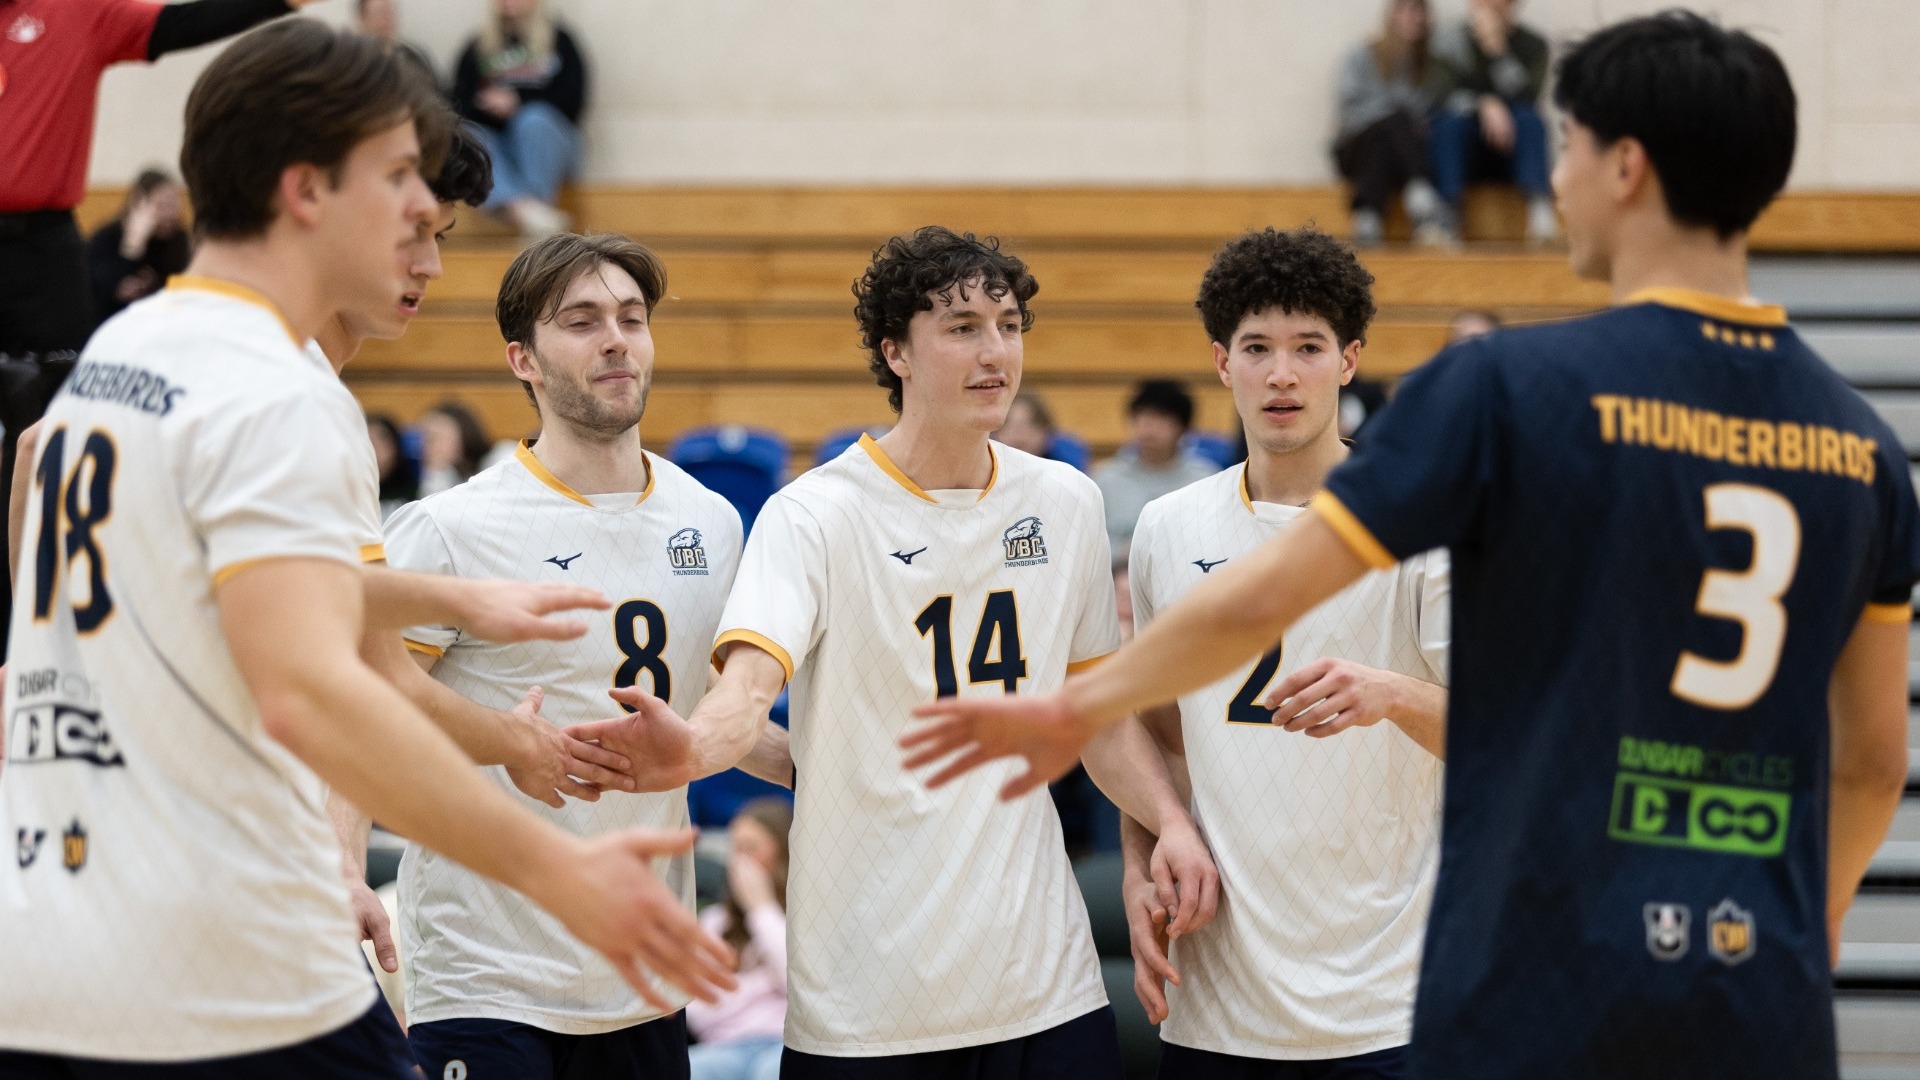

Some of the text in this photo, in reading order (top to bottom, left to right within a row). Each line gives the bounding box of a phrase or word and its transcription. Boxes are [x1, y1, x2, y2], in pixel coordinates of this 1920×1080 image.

[1592, 394, 1878, 486] THUNDERBIRDS
[32, 423, 119, 640] 18
[667, 548, 708, 569] UBC
[1002, 536, 1048, 561] UBC
[912, 587, 1030, 703] 14
[1669, 481, 1803, 711] 3
[612, 597, 672, 716] 8
